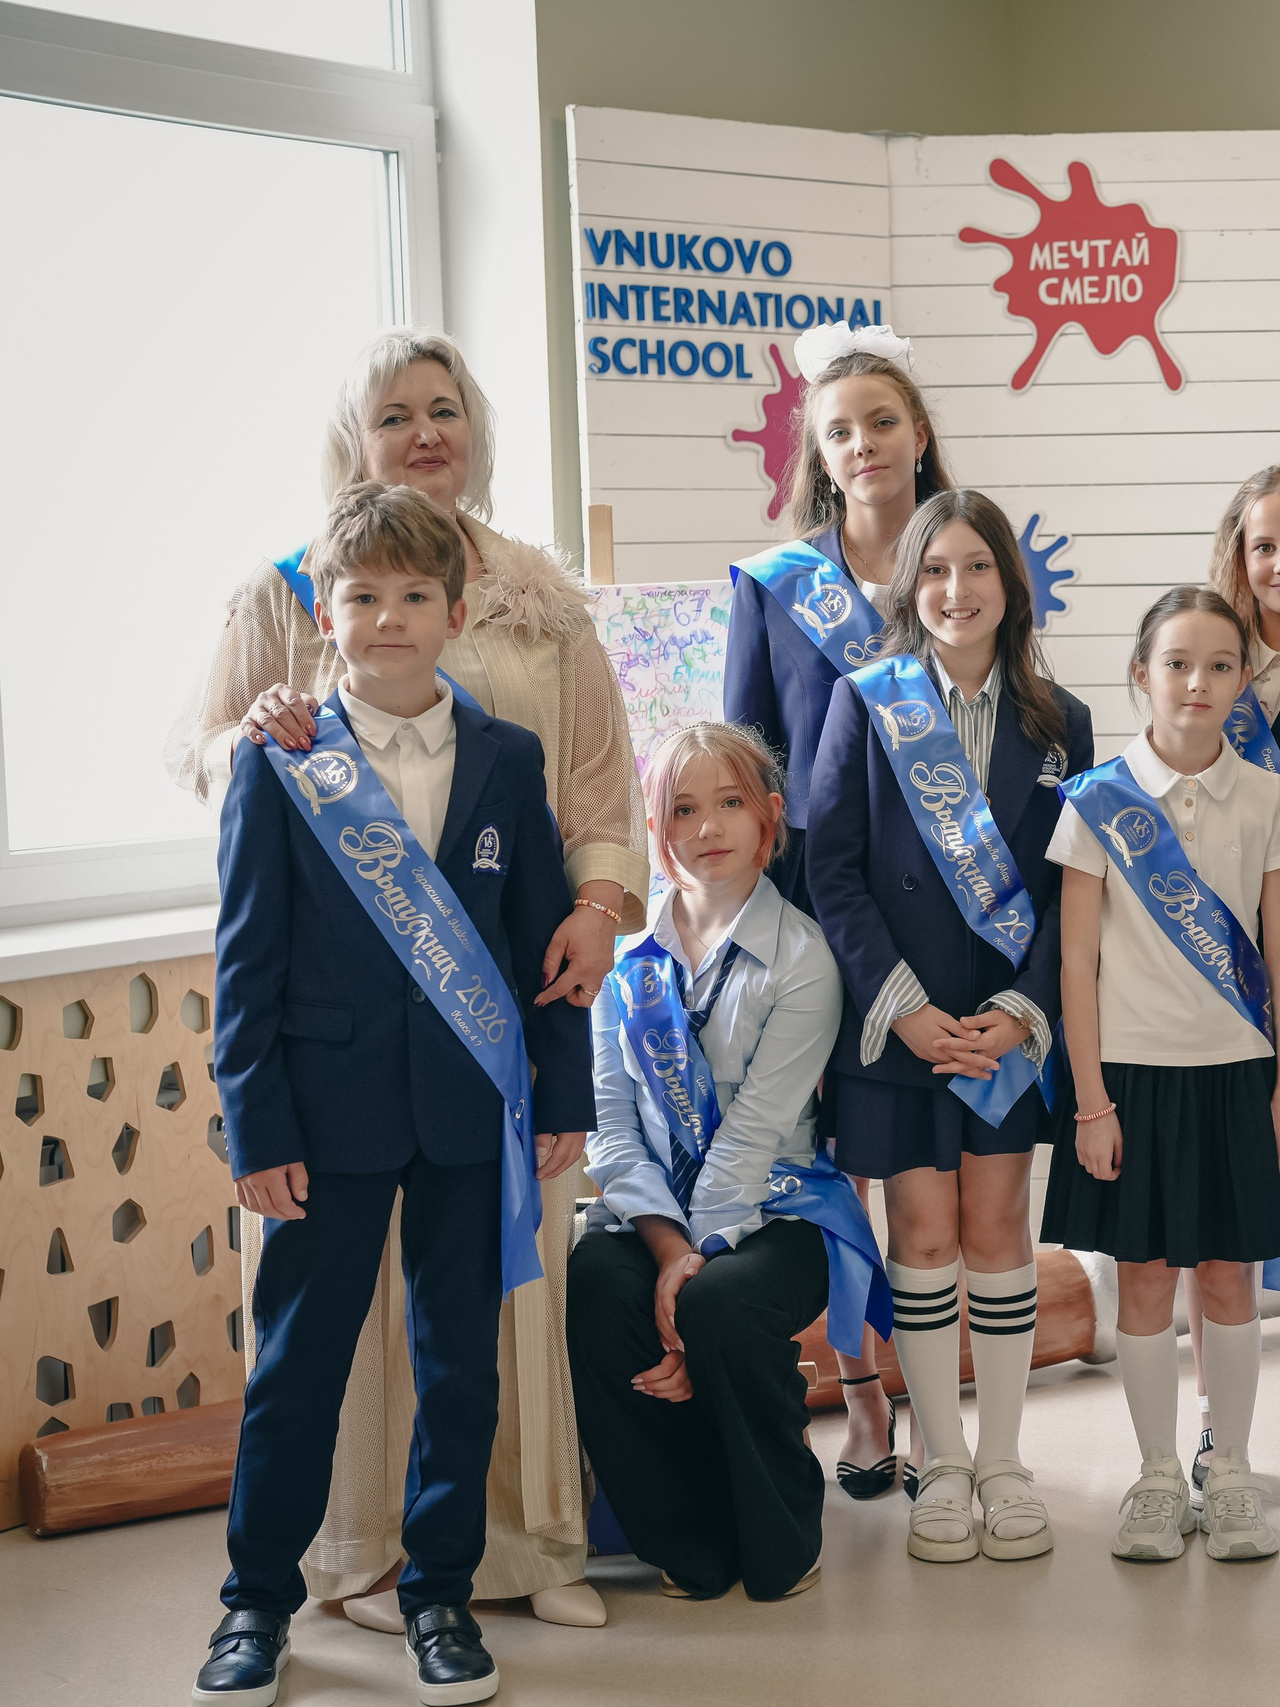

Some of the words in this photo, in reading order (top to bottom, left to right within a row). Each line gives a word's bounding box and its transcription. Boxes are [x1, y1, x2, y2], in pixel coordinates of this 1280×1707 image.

[585, 227, 792, 277] VNUKOVO
[1028, 231, 1150, 271] МЕЧТАЙ
[1038, 273, 1143, 306] СМЕЛО
[588, 336, 752, 379] SCHOOL
[411, 866, 450, 918] Герасимов
[339, 821, 461, 993] Выпускник
[456, 975, 508, 1044] 2026
[994, 908, 1031, 951] 20
[451, 1009, 472, 1036] Класс
